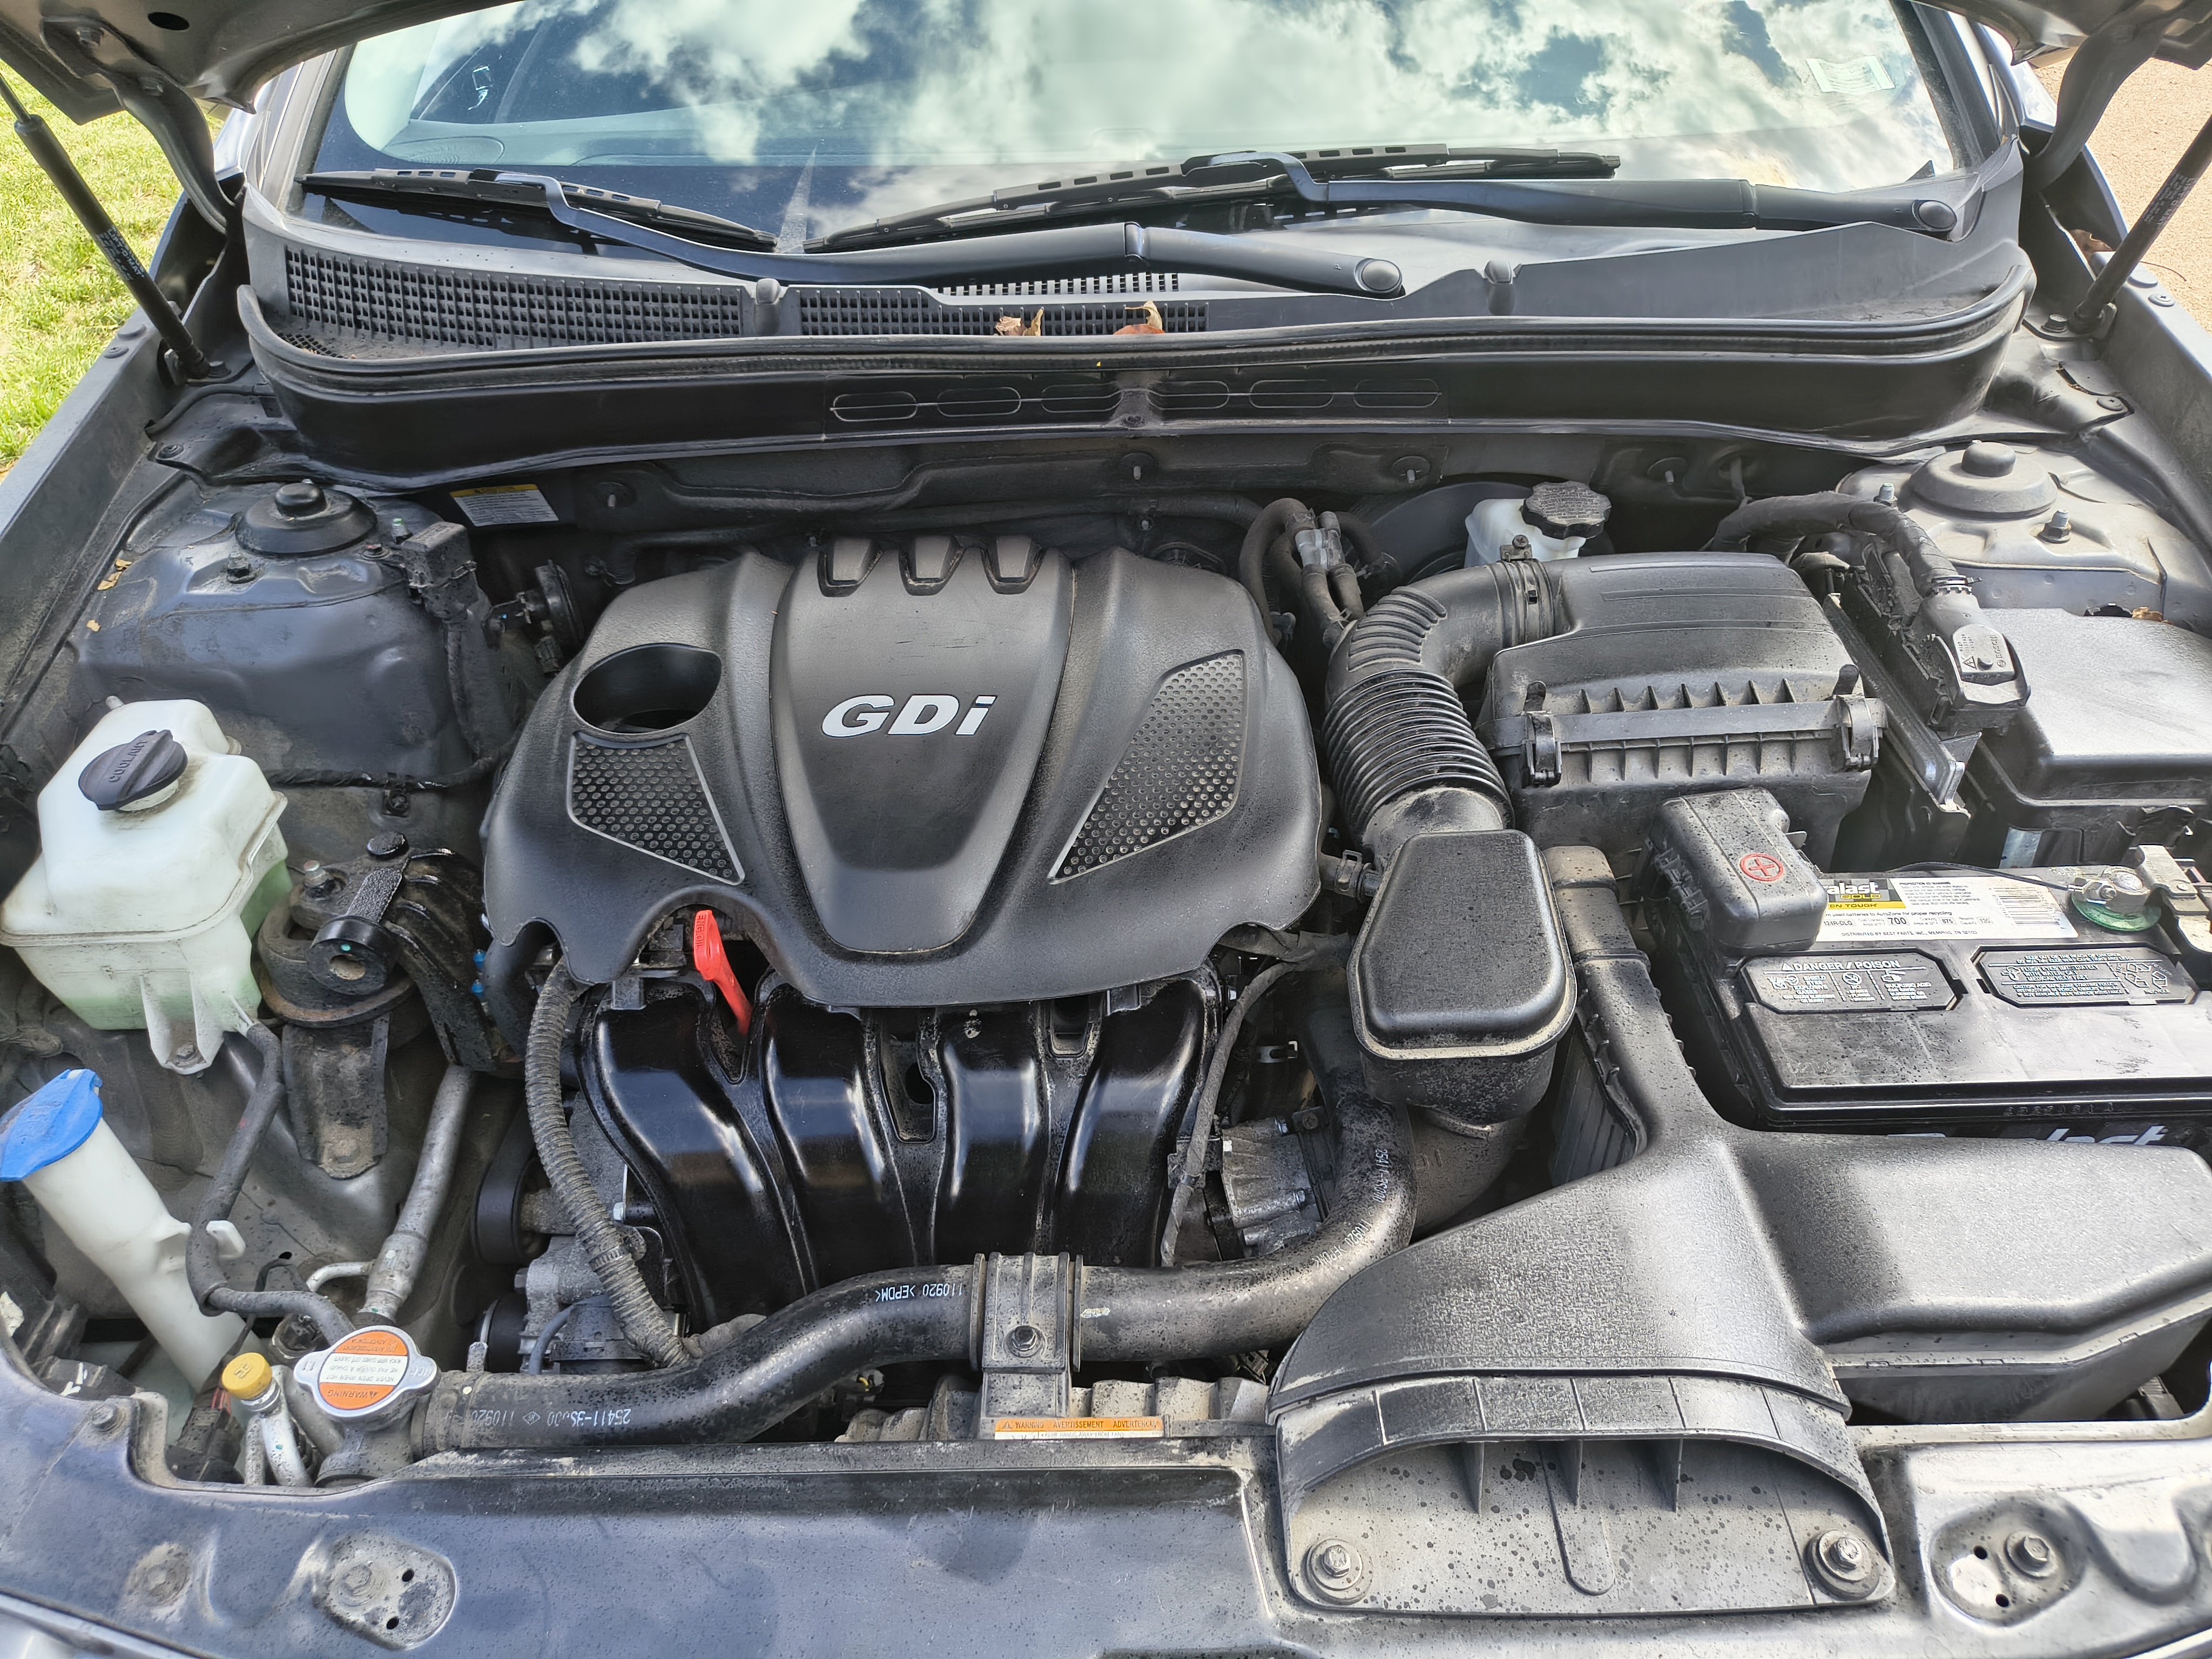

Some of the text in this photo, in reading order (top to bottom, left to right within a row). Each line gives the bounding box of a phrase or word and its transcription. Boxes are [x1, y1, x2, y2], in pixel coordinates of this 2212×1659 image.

[1990, 636, 2003, 658] BOSCH
[822, 694, 999, 738] GDi
[109, 741, 148, 783] COOLANT
[695, 914, 705, 950] ENG OIL
[1793, 962, 1844, 971] DANGER
[1854, 960, 1901, 969] POISON
[922, 1283, 963, 1297] 110920
[328, 1390, 368, 1398] WARNING
[1053, 1420, 1104, 1429] AVERTISSEMENT
